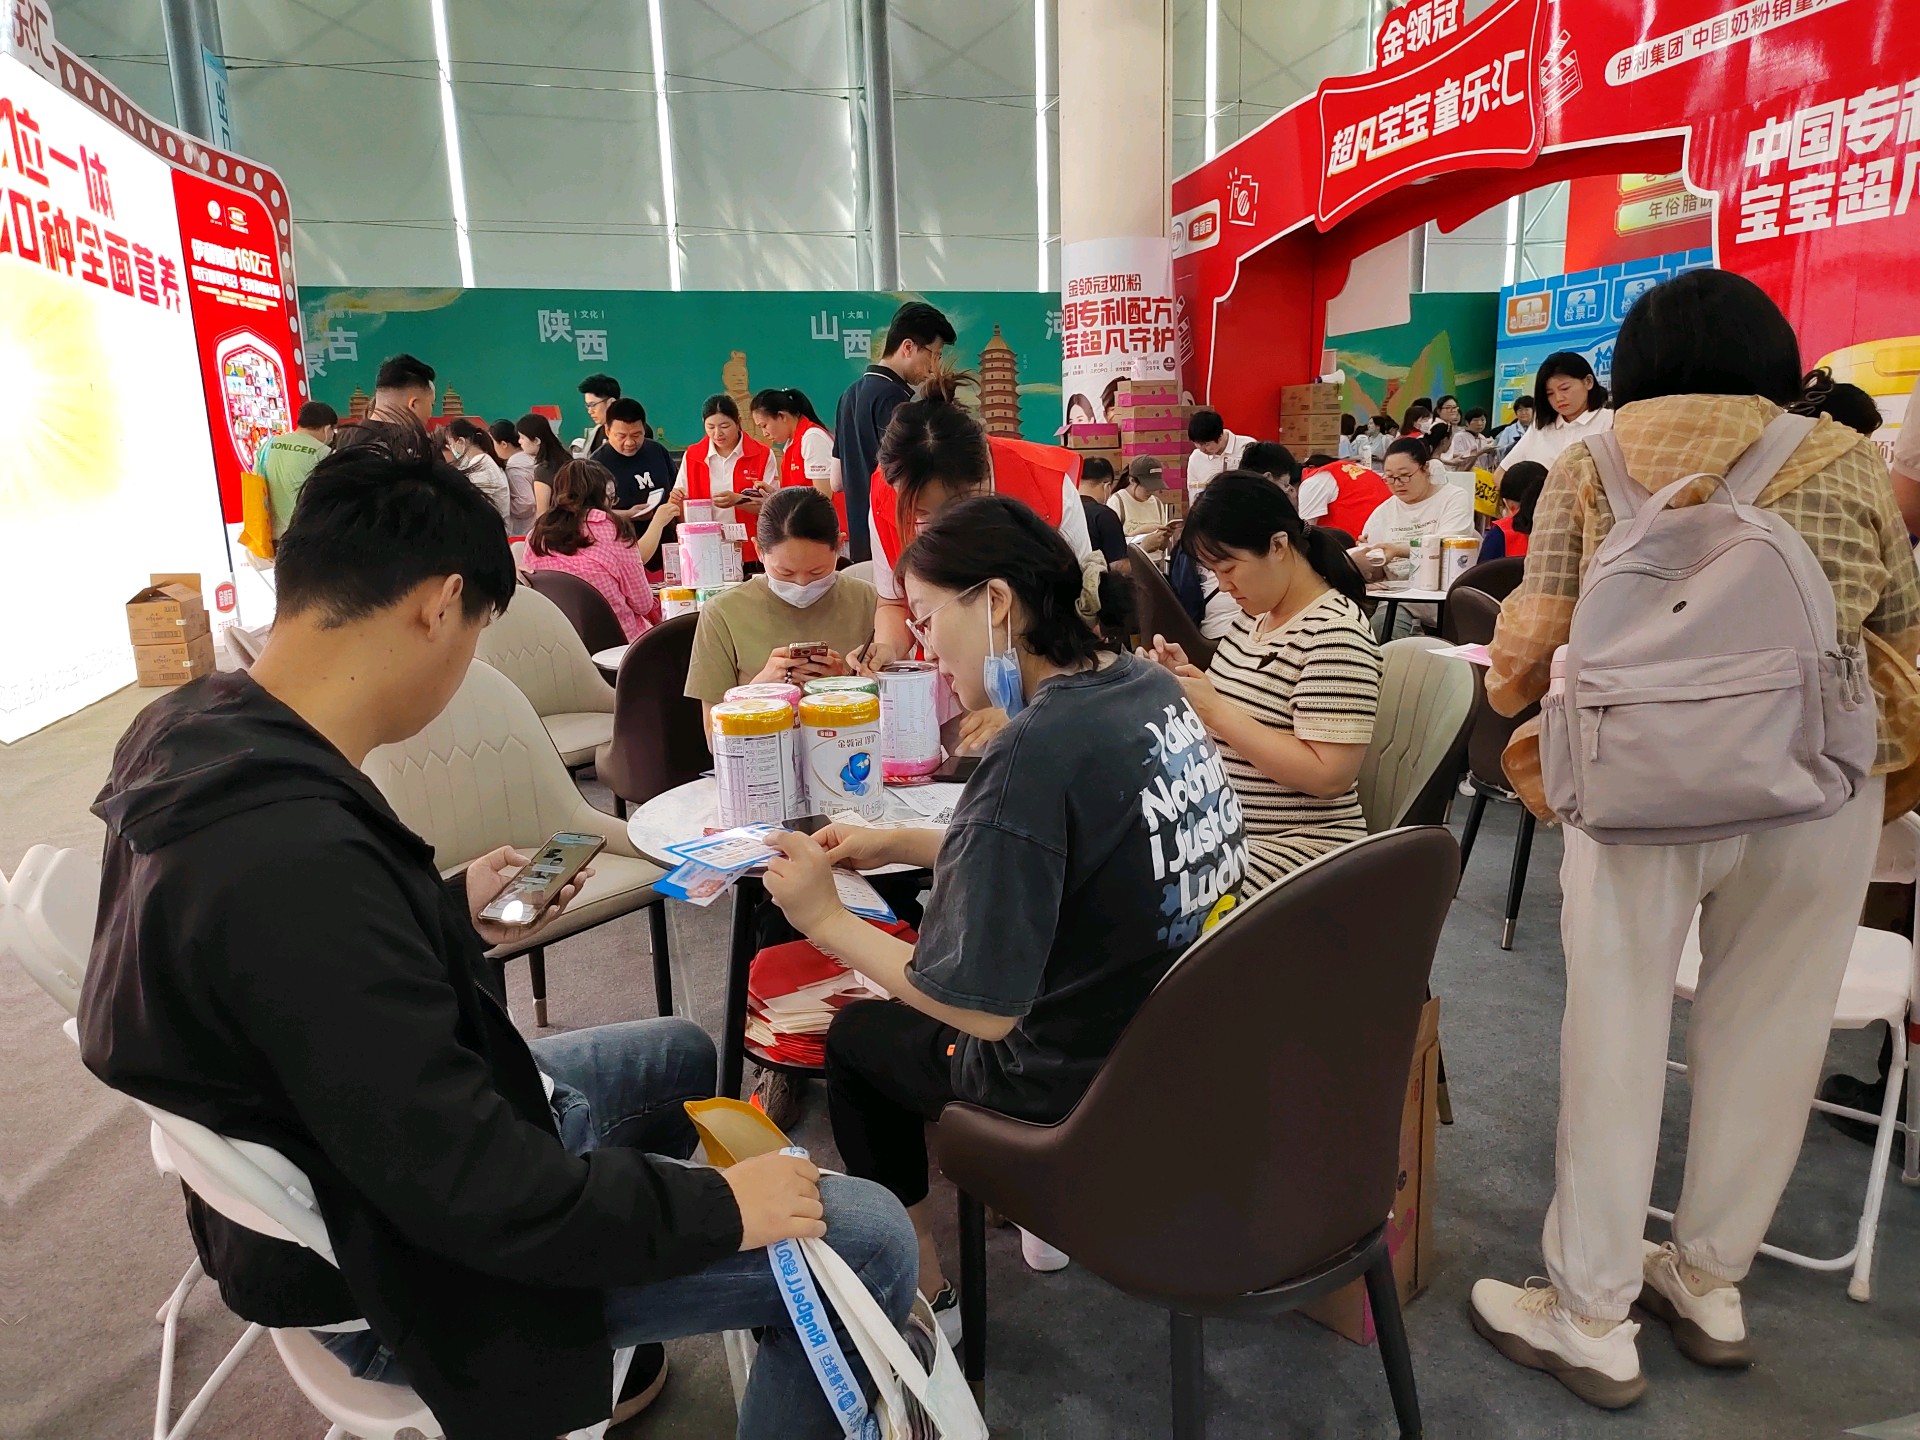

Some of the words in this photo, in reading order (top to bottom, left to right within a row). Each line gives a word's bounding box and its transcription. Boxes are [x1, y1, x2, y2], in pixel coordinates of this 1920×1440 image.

[1382, 0, 1458, 67] 金领冠
[1617, 35, 1684, 80] 伊利集团
[1327, 49, 1525, 177] 超凡宝宝童乐汇
[1068, 273, 1142, 298] 金领冠奶粉
[1578, 293, 1586, 304] 2
[1636, 282, 1646, 295] 3
[580, 310, 599, 319] 文化
[1062, 296, 1173, 331] 国专利配方
[1564, 304, 1598, 322] 检票口
[538, 309, 608, 361] 陕西
[811, 311, 872, 360] 山西
[1061, 326, 1175, 361] 宝超凡守护
[634, 472, 655, 490] M
[1150, 834, 1166, 880] I
[1170, 805, 1223, 873] Just
